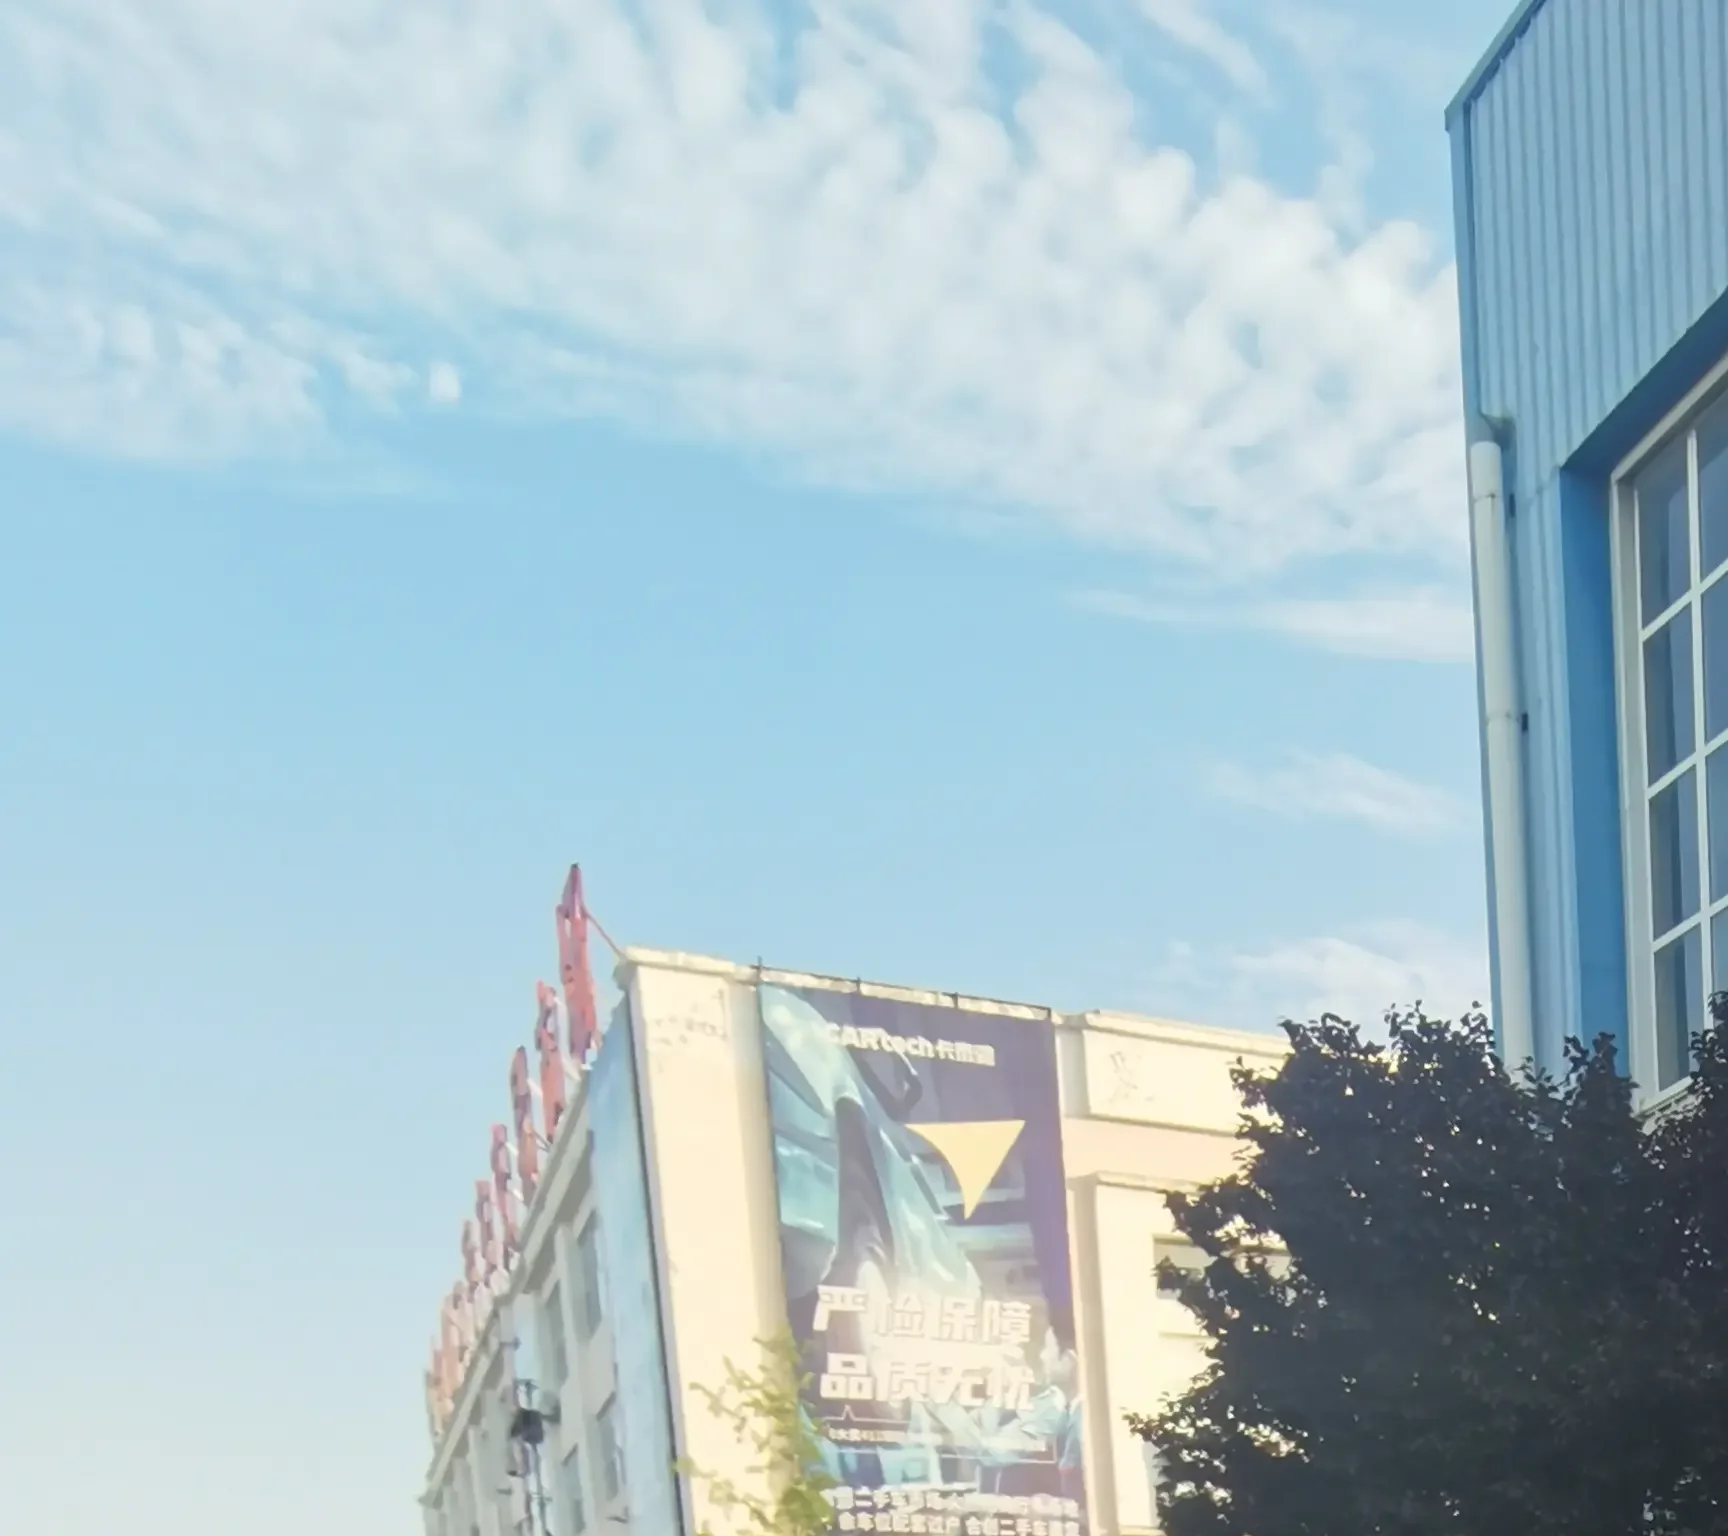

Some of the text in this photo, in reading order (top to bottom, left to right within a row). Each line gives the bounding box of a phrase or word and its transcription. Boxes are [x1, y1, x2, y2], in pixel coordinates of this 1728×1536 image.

[812, 1284, 1032, 1345] 严检保障
[820, 1352, 1035, 1411] 品质无忧
